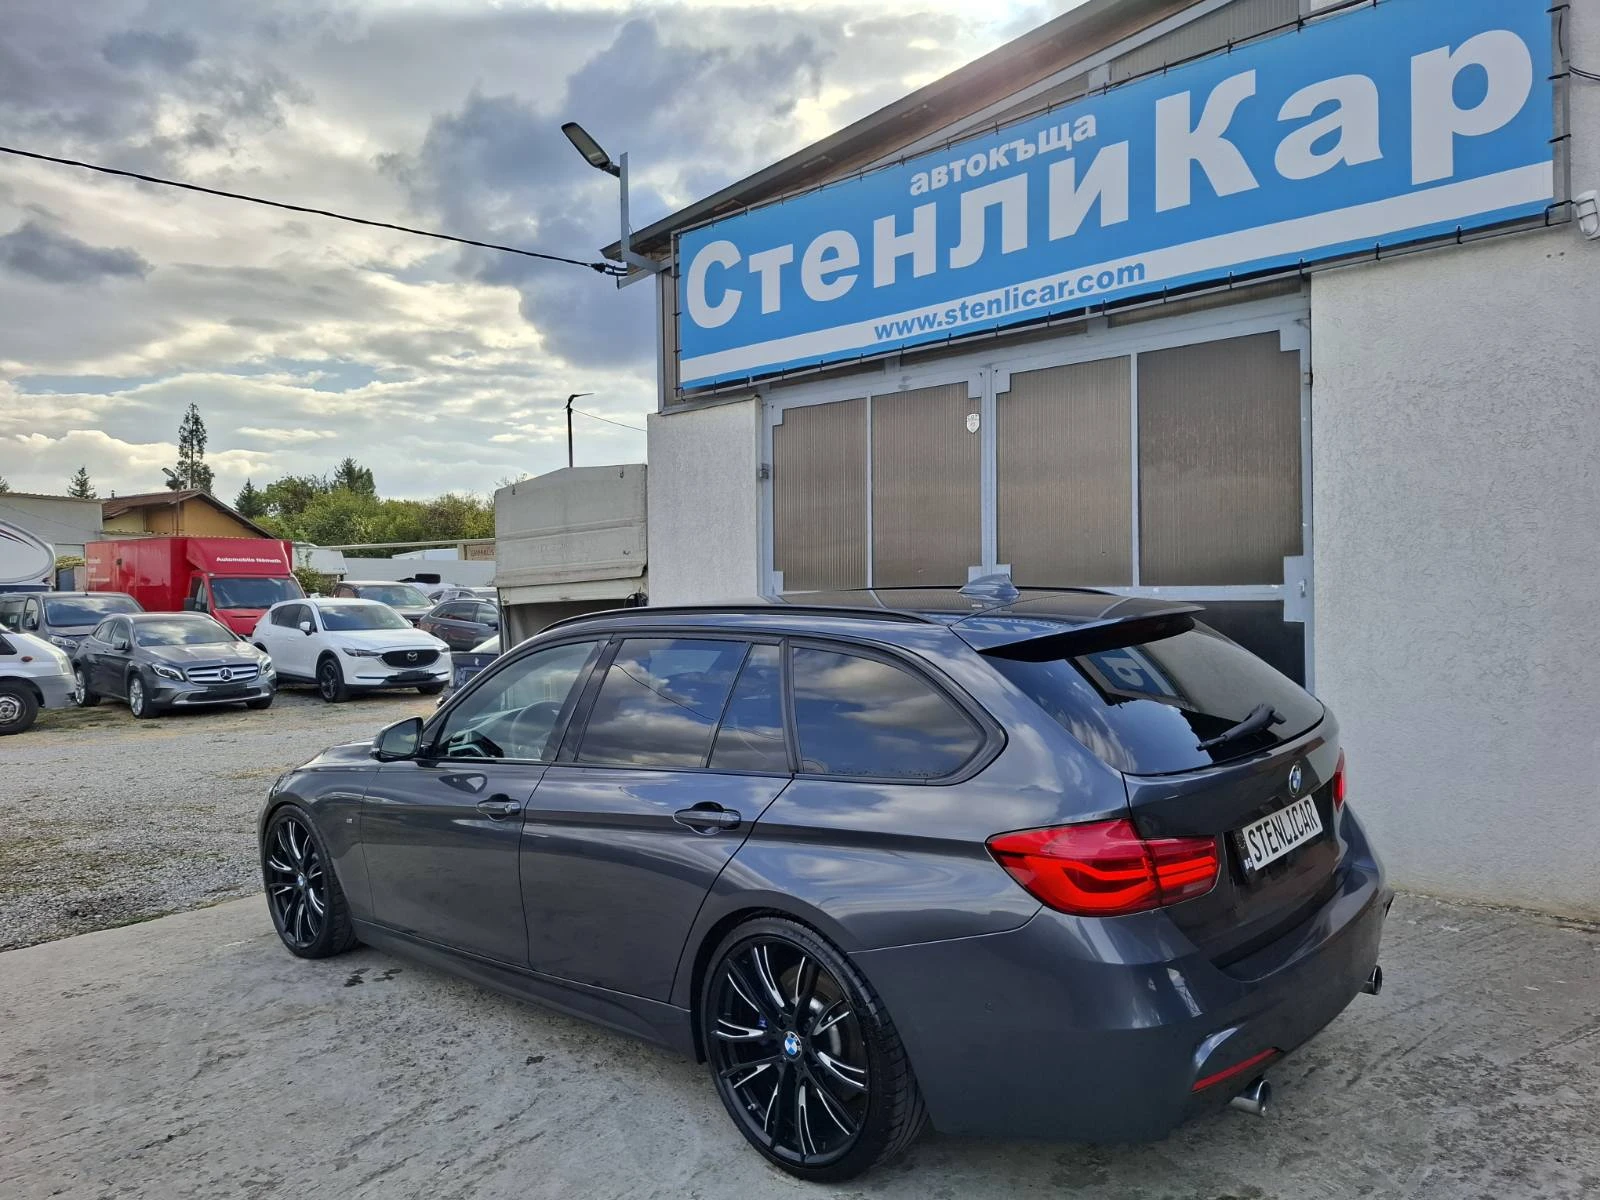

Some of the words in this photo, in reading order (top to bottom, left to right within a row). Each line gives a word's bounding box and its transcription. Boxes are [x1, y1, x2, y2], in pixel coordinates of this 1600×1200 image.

[686, 29, 1533, 329] СтенлиКар
[910, 114, 1097, 196] автокъща
[874, 262, 1145, 340] www.stenlicar.com
[1248, 799, 1318, 862] STENLICAR
